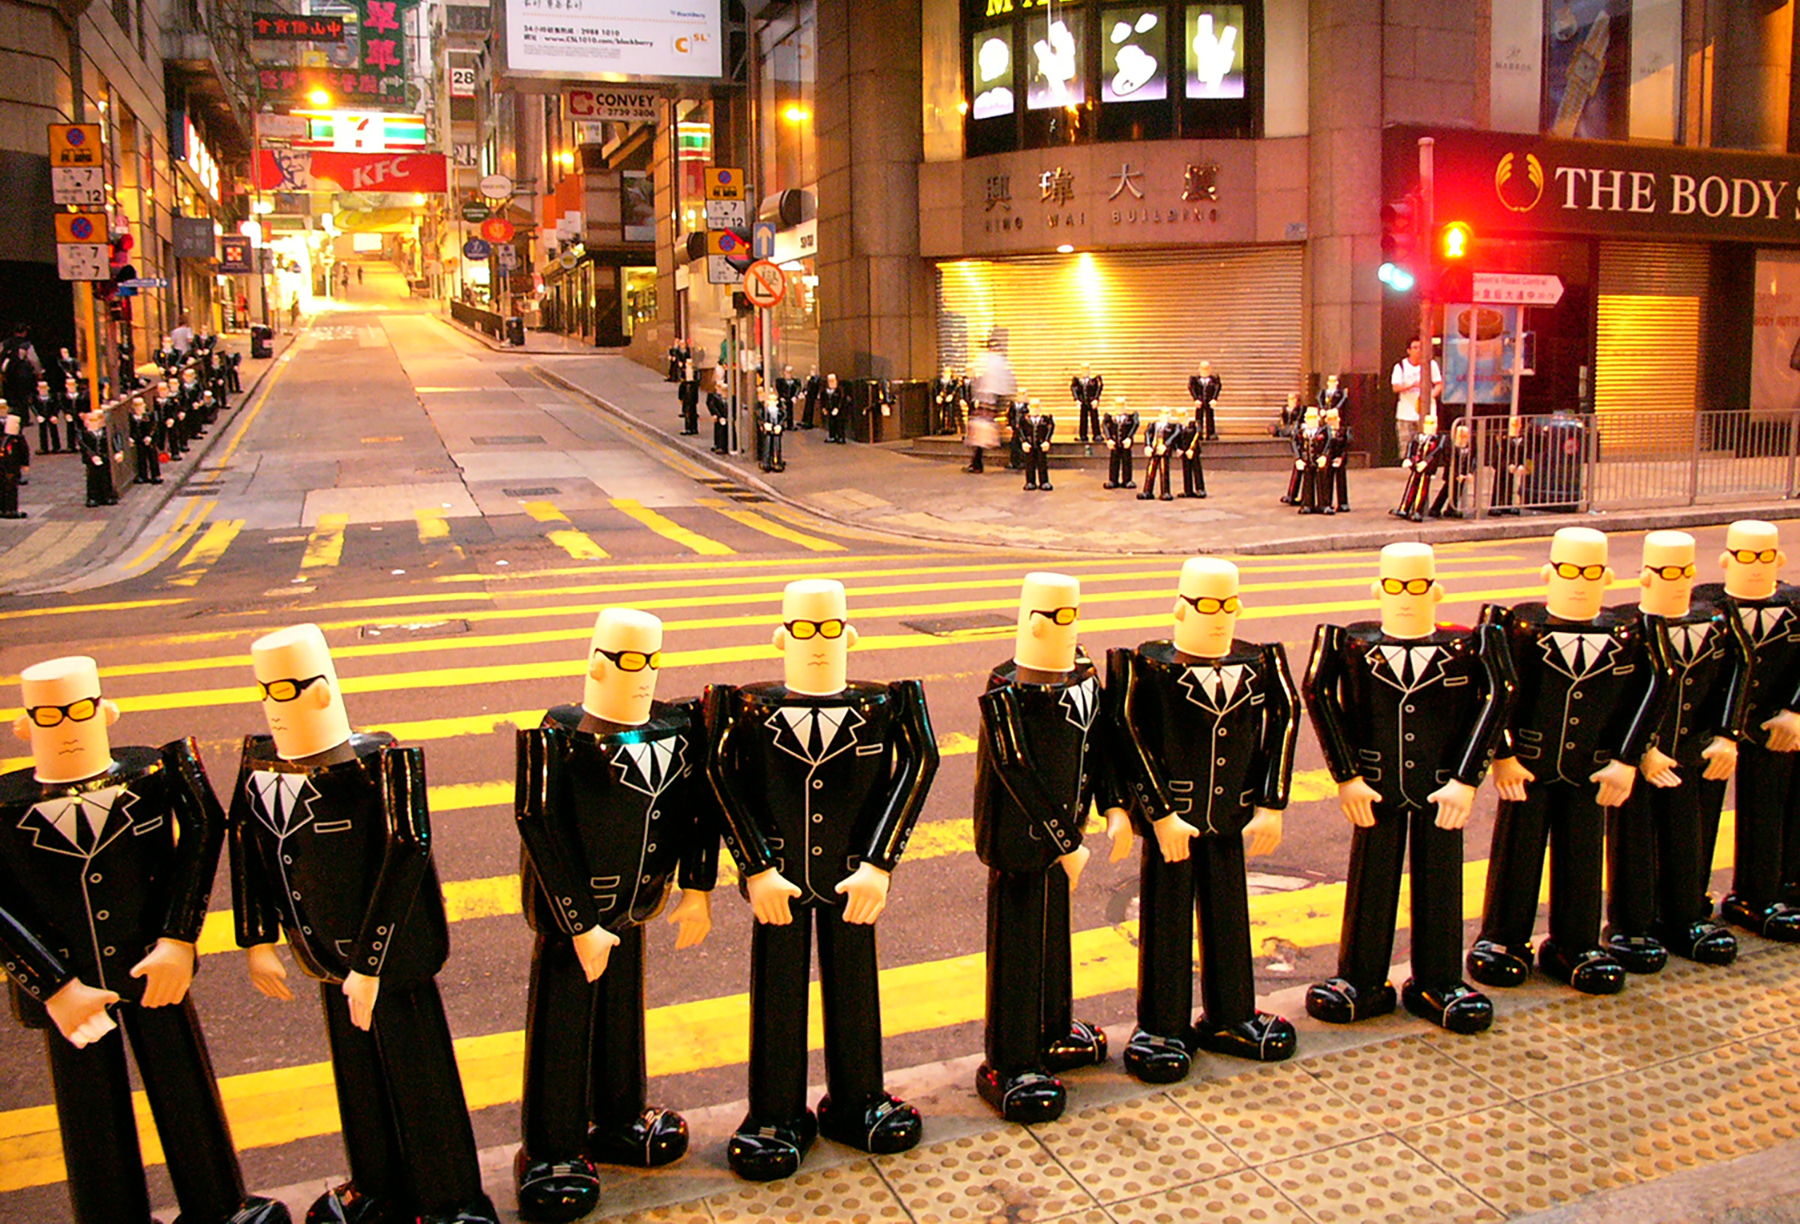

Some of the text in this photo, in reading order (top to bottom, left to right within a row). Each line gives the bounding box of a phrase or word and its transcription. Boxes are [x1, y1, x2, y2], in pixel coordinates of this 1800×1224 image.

[602, 29, 620, 37] 1010
[454, 71, 474, 84] 28
[596, 93, 654, 107] CONVEY
[84, 169, 92, 181] 7
[352, 156, 410, 189] KFC
[86, 189, 101, 202] 12
[1554, 166, 1657, 213] THE
[1670, 174, 1789, 219] BODY
[731, 202, 737, 212] 7
[732, 217, 743, 228] 12
[1047, 212, 1085, 229] WAI
[1112, 208, 1218, 225] BUILDING
[90, 246, 99, 258] 7
[91, 265, 100, 277] 7
